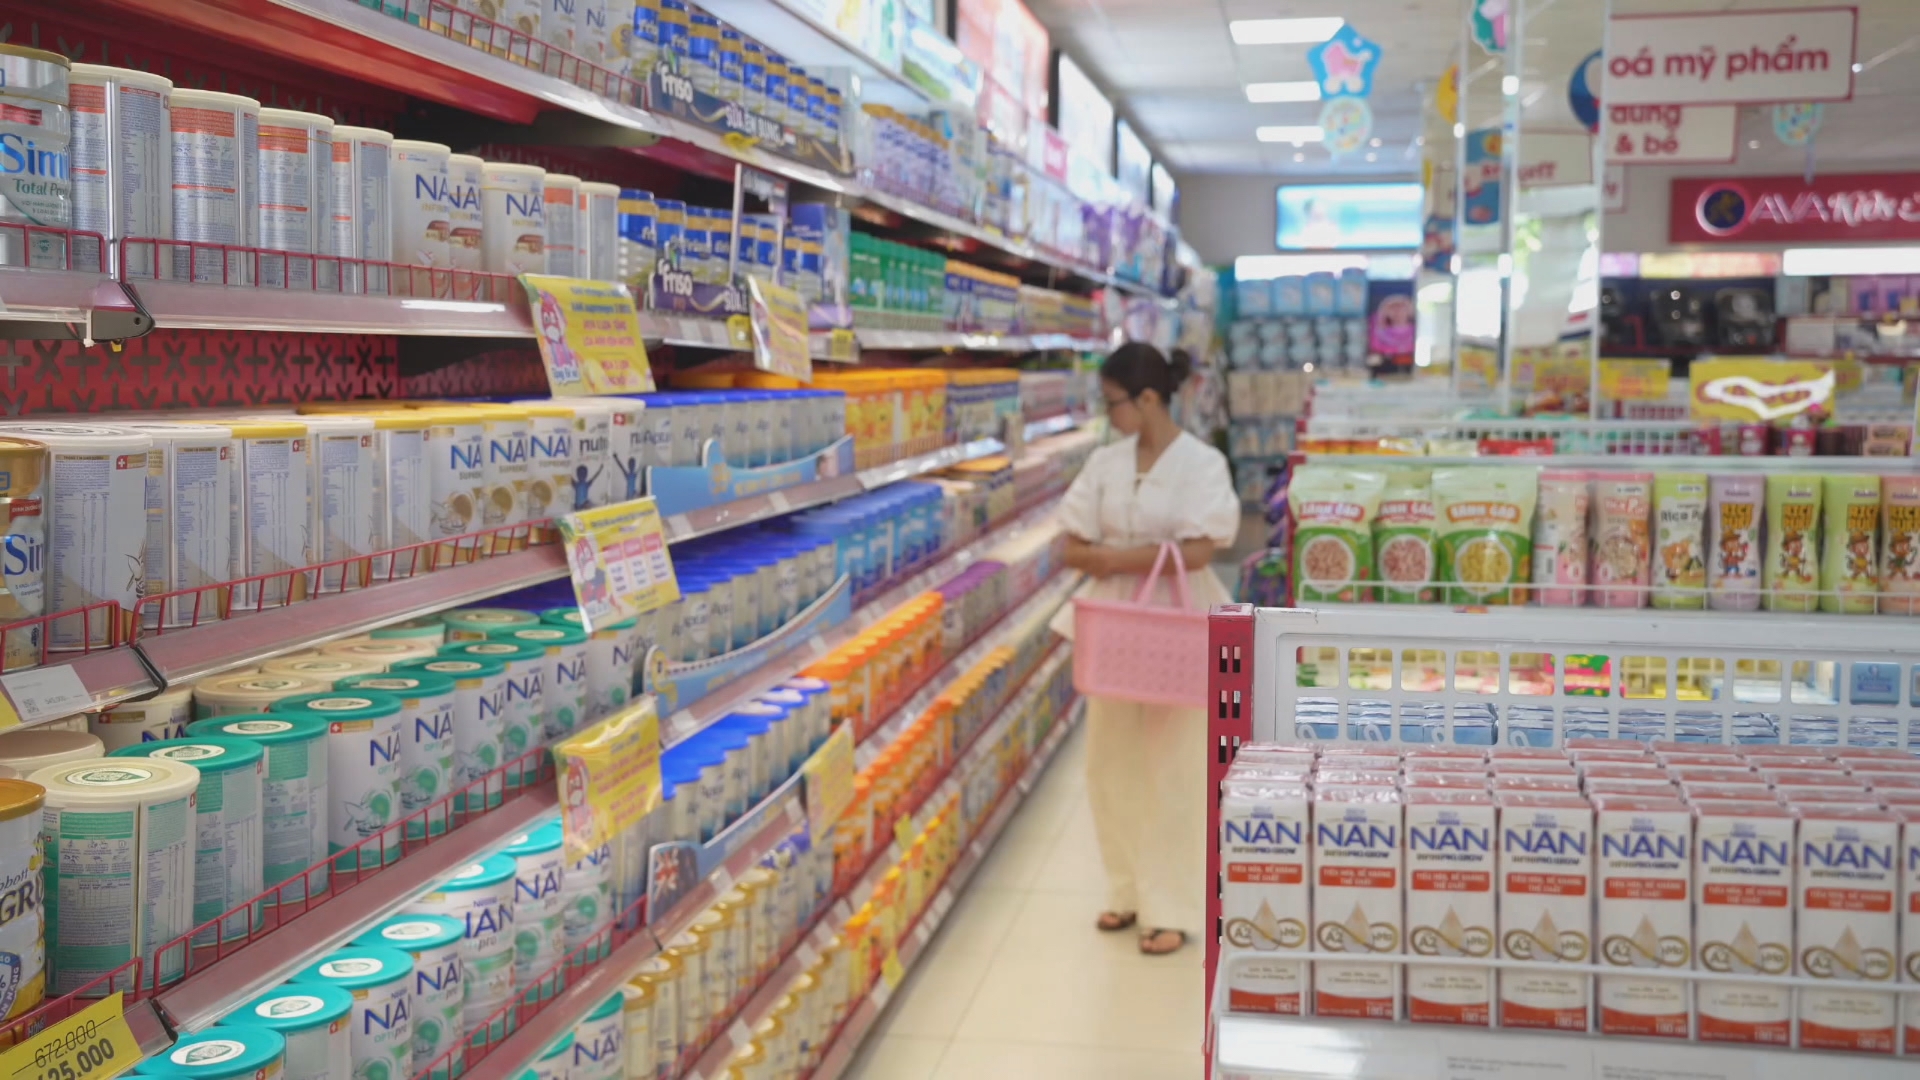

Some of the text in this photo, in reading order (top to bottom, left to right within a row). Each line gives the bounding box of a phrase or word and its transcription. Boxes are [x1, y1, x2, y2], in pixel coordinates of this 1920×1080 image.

[1664, 46, 1717, 81] mỹ
[1725, 34, 1829, 81] phẩm
[1615, 136, 1634, 155] &
[12, 178, 47, 196] Total
[490, 439, 528, 463] NA
[1225, 820, 1302, 845] NAN
[1317, 823, 1395, 848] NAN
[1409, 826, 1490, 851] NAN
[1505, 829, 1587, 855] NAN
[1602, 834, 1687, 859] NAN
[1701, 839, 1788, 866] NAN
[1804, 841, 1893, 870] NAN
[1325, 928, 1343, 943] A2
[1418, 934, 1437, 948] A2
[417, 958, 462, 995] NA
[364, 993, 411, 1035] NA
[35, 1019, 97, 1068] 672.000
[38, 1038, 115, 1080] 25.000
